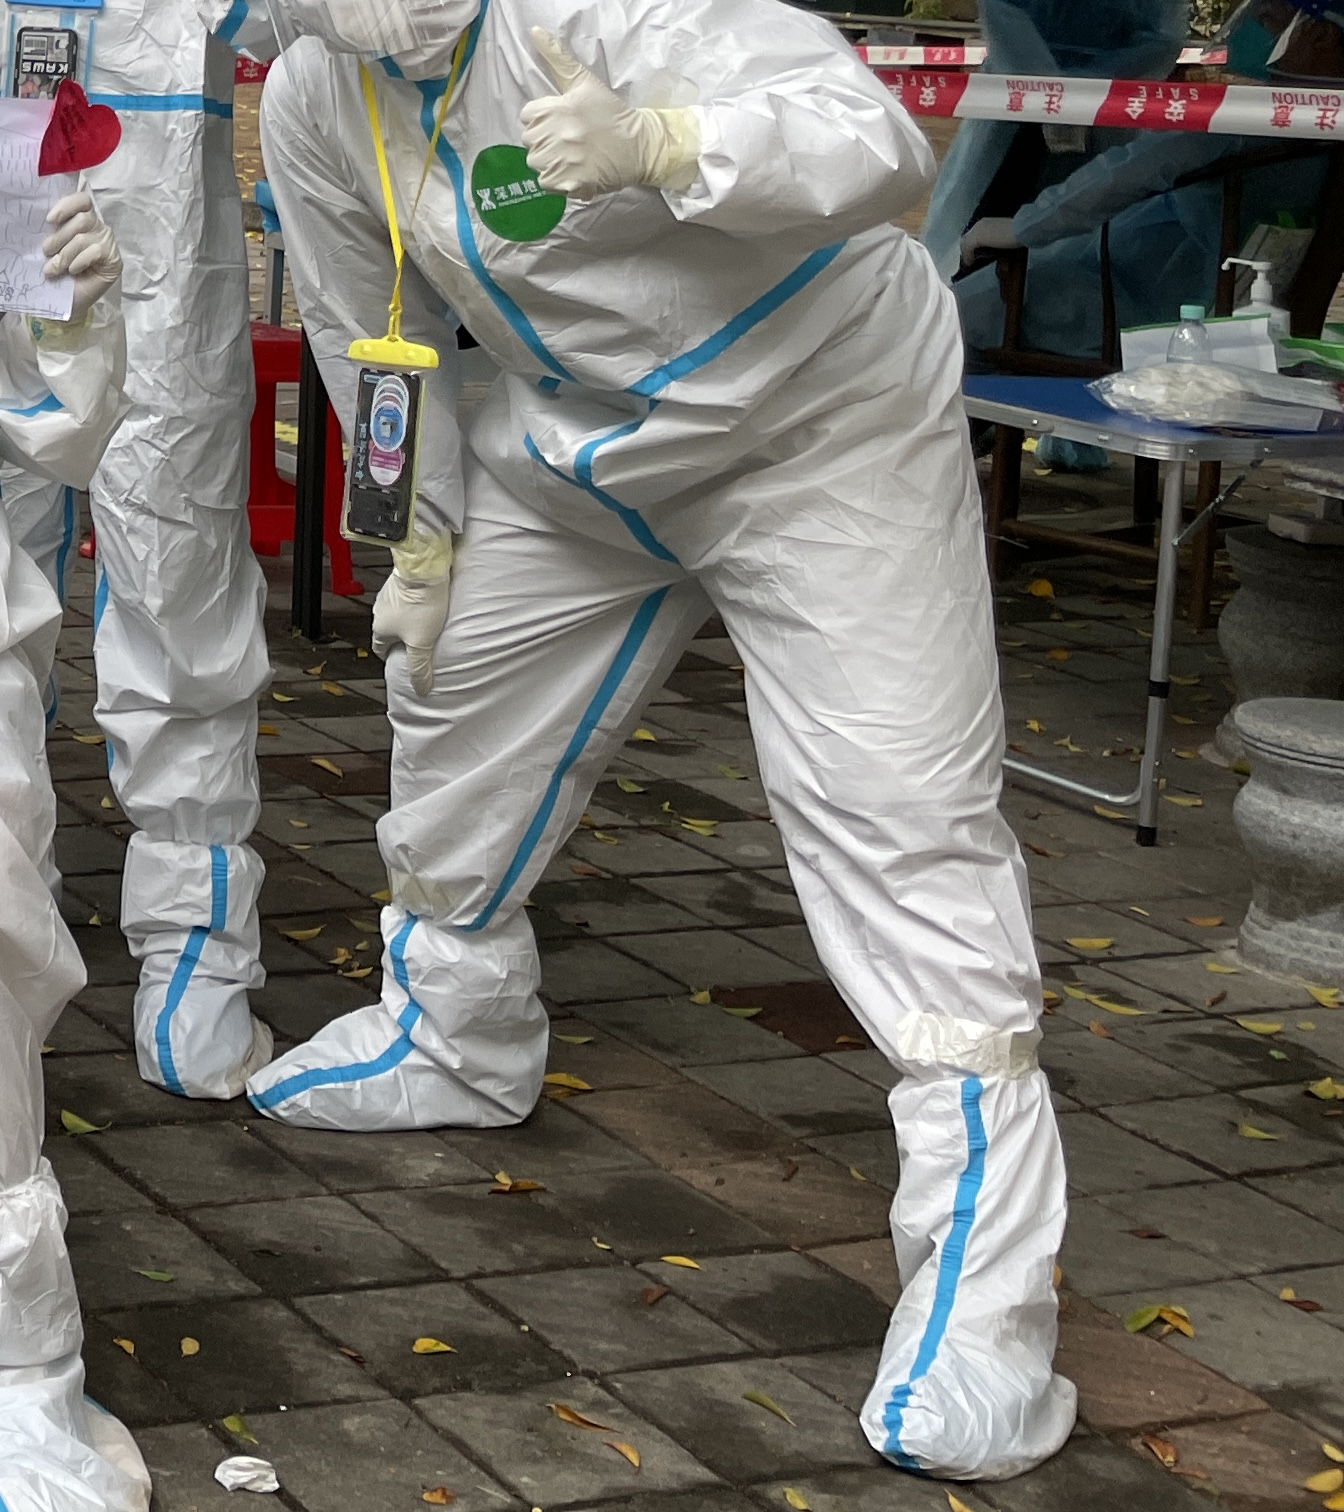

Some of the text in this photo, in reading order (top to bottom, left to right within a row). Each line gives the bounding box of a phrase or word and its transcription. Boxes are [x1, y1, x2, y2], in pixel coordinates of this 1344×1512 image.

[1005, 79, 1064, 93] CAUTION
[1137, 85, 1200, 100] SAFE
[1006, 92, 1063, 115] 注意
[1124, 97, 1186, 122] 安全
[1271, 91, 1341, 108] CAUTION
[1269, 106, 1340, 131] 注意
